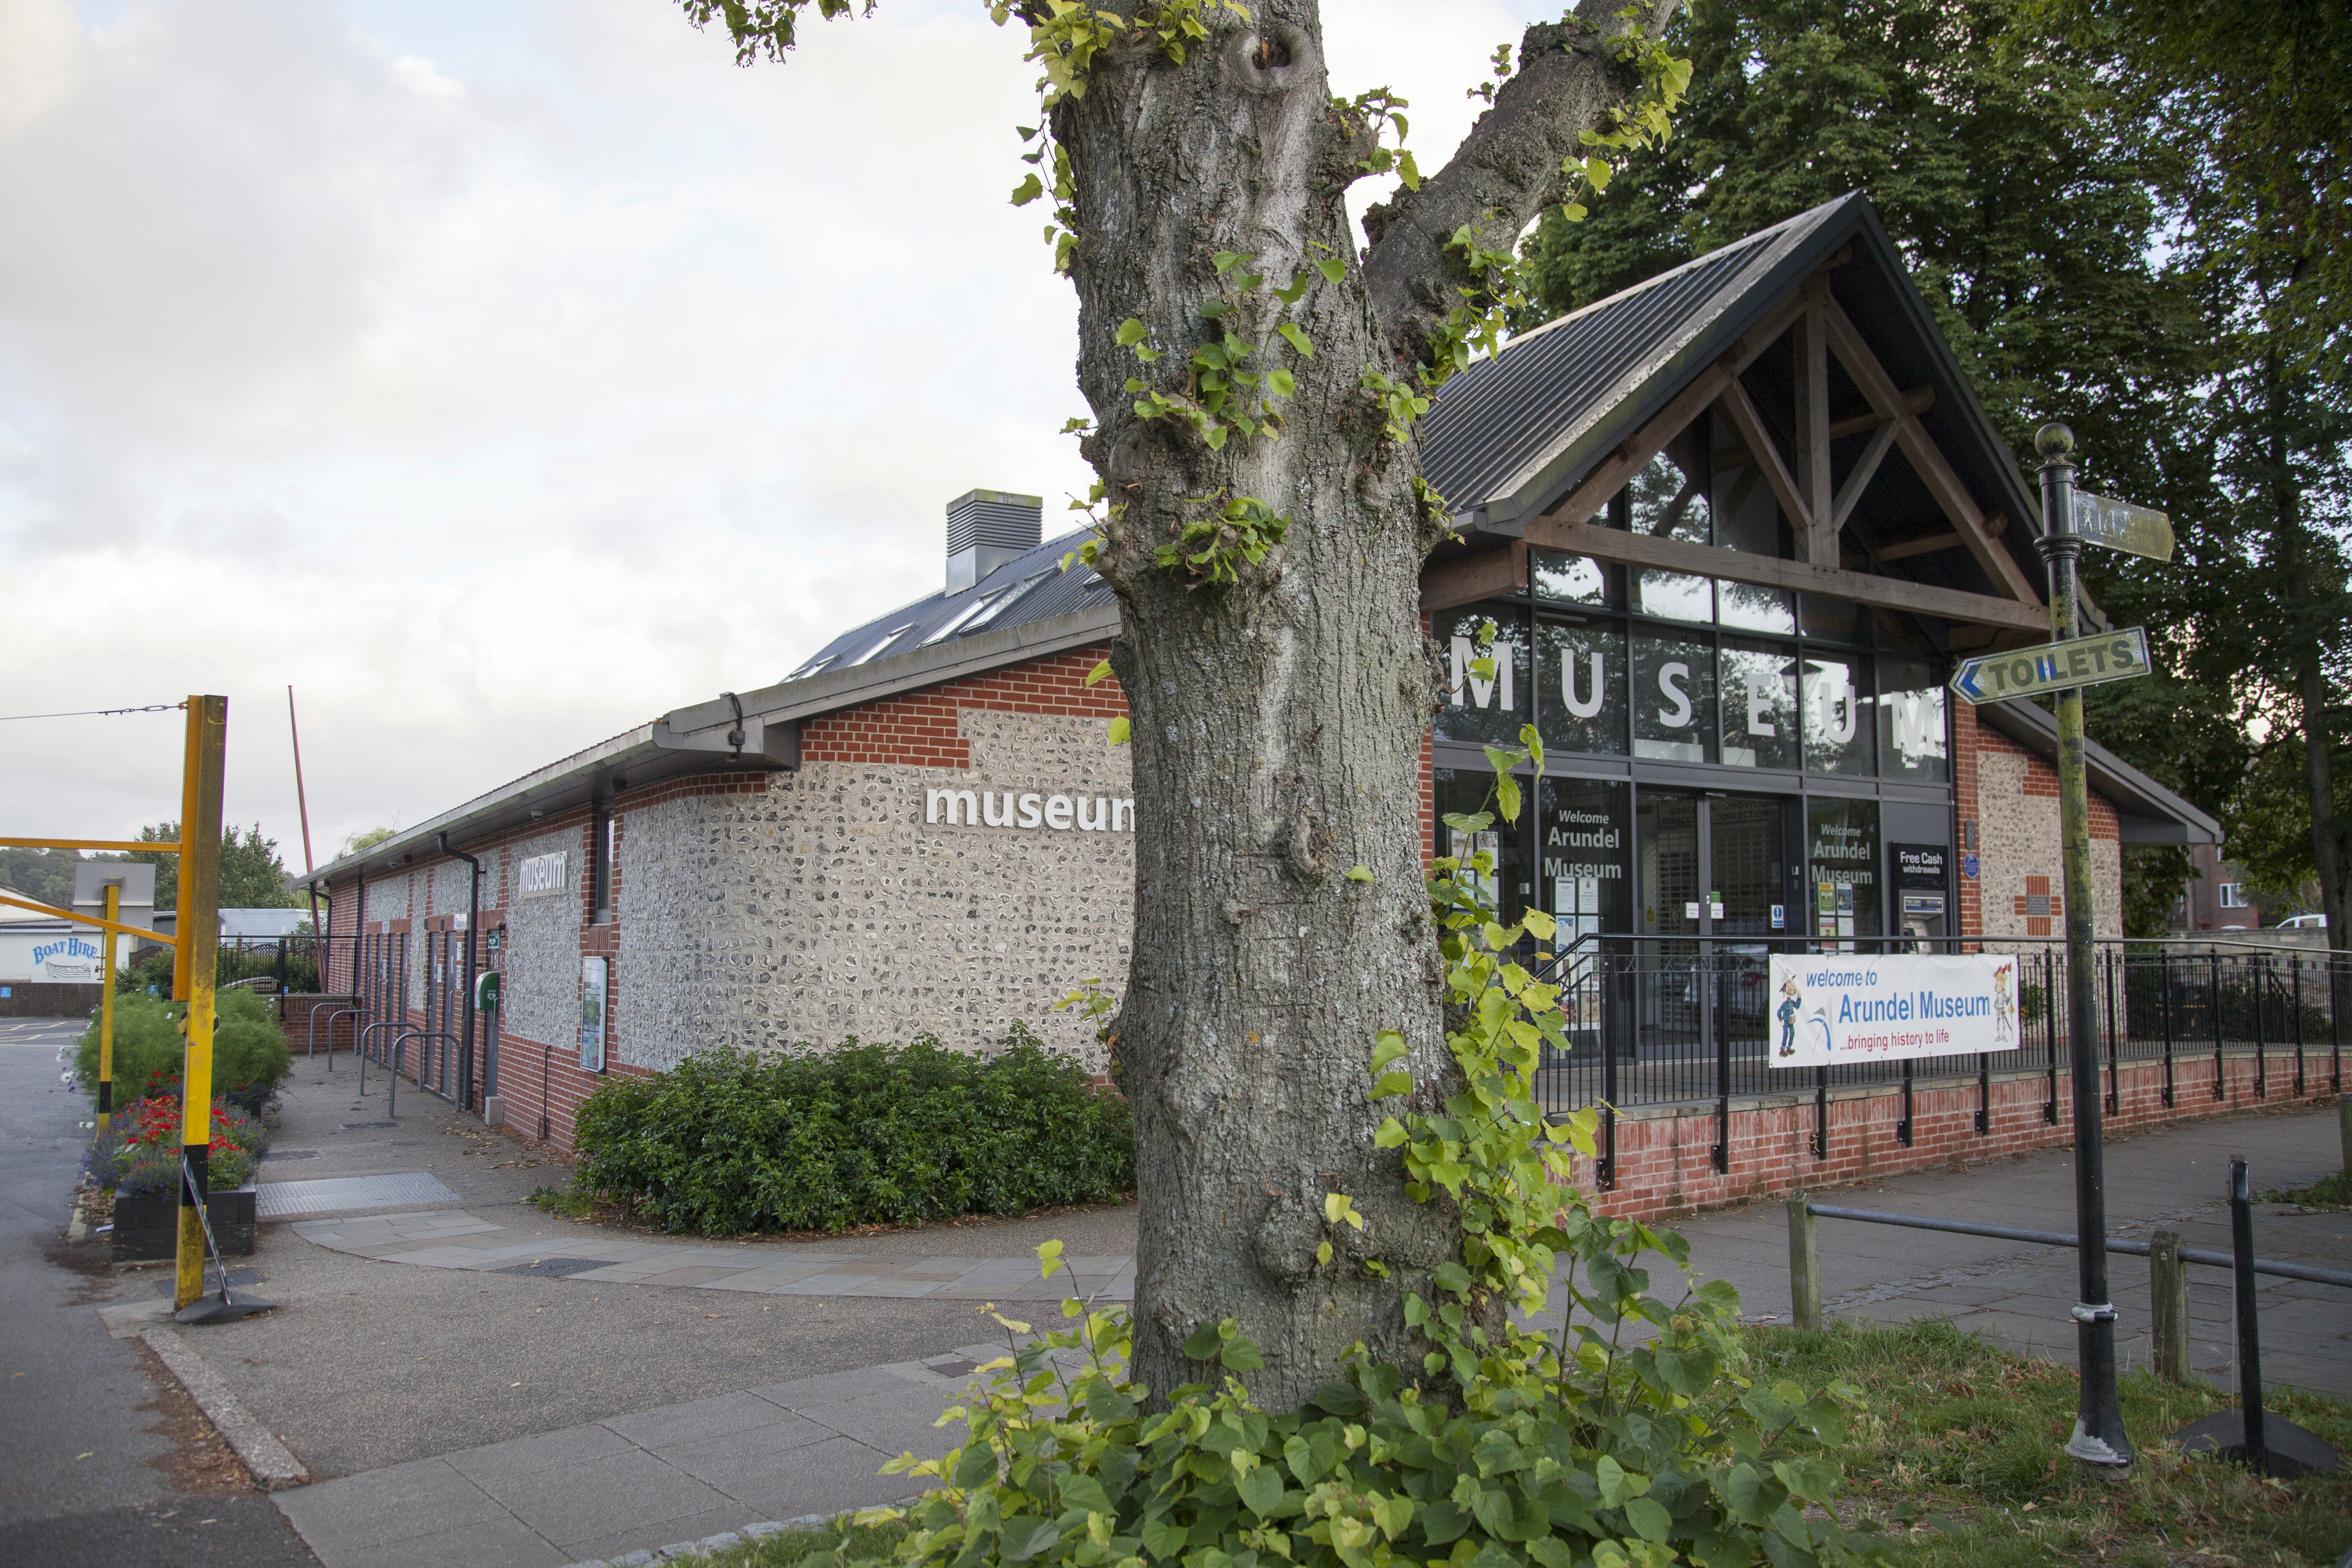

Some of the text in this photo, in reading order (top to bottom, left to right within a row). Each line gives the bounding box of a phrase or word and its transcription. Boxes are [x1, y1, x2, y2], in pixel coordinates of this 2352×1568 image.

[1988, 640, 2133, 691] TOILETS
[1451, 636, 1936, 754] MUSEUM
[1559, 810, 1609, 824] Welcome
[1547, 826, 1620, 848] Arundel
[1821, 824, 1861, 837] Welcome
[1813, 840, 1870, 859] Arundel
[1900, 851, 1942, 864] Free Cash
[519, 856, 566, 893] museum
[1545, 857, 1622, 879] Museum
[1811, 864, 1872, 885] Museum
[1903, 864, 1940, 874] withdrawals
[33, 938, 98, 965] BOAT HIRE
[1806, 968, 1877, 987] welcome to
[1839, 991, 1990, 1024] Arundel Museum
[1840, 1029, 1949, 1052] ...bringing history to life
